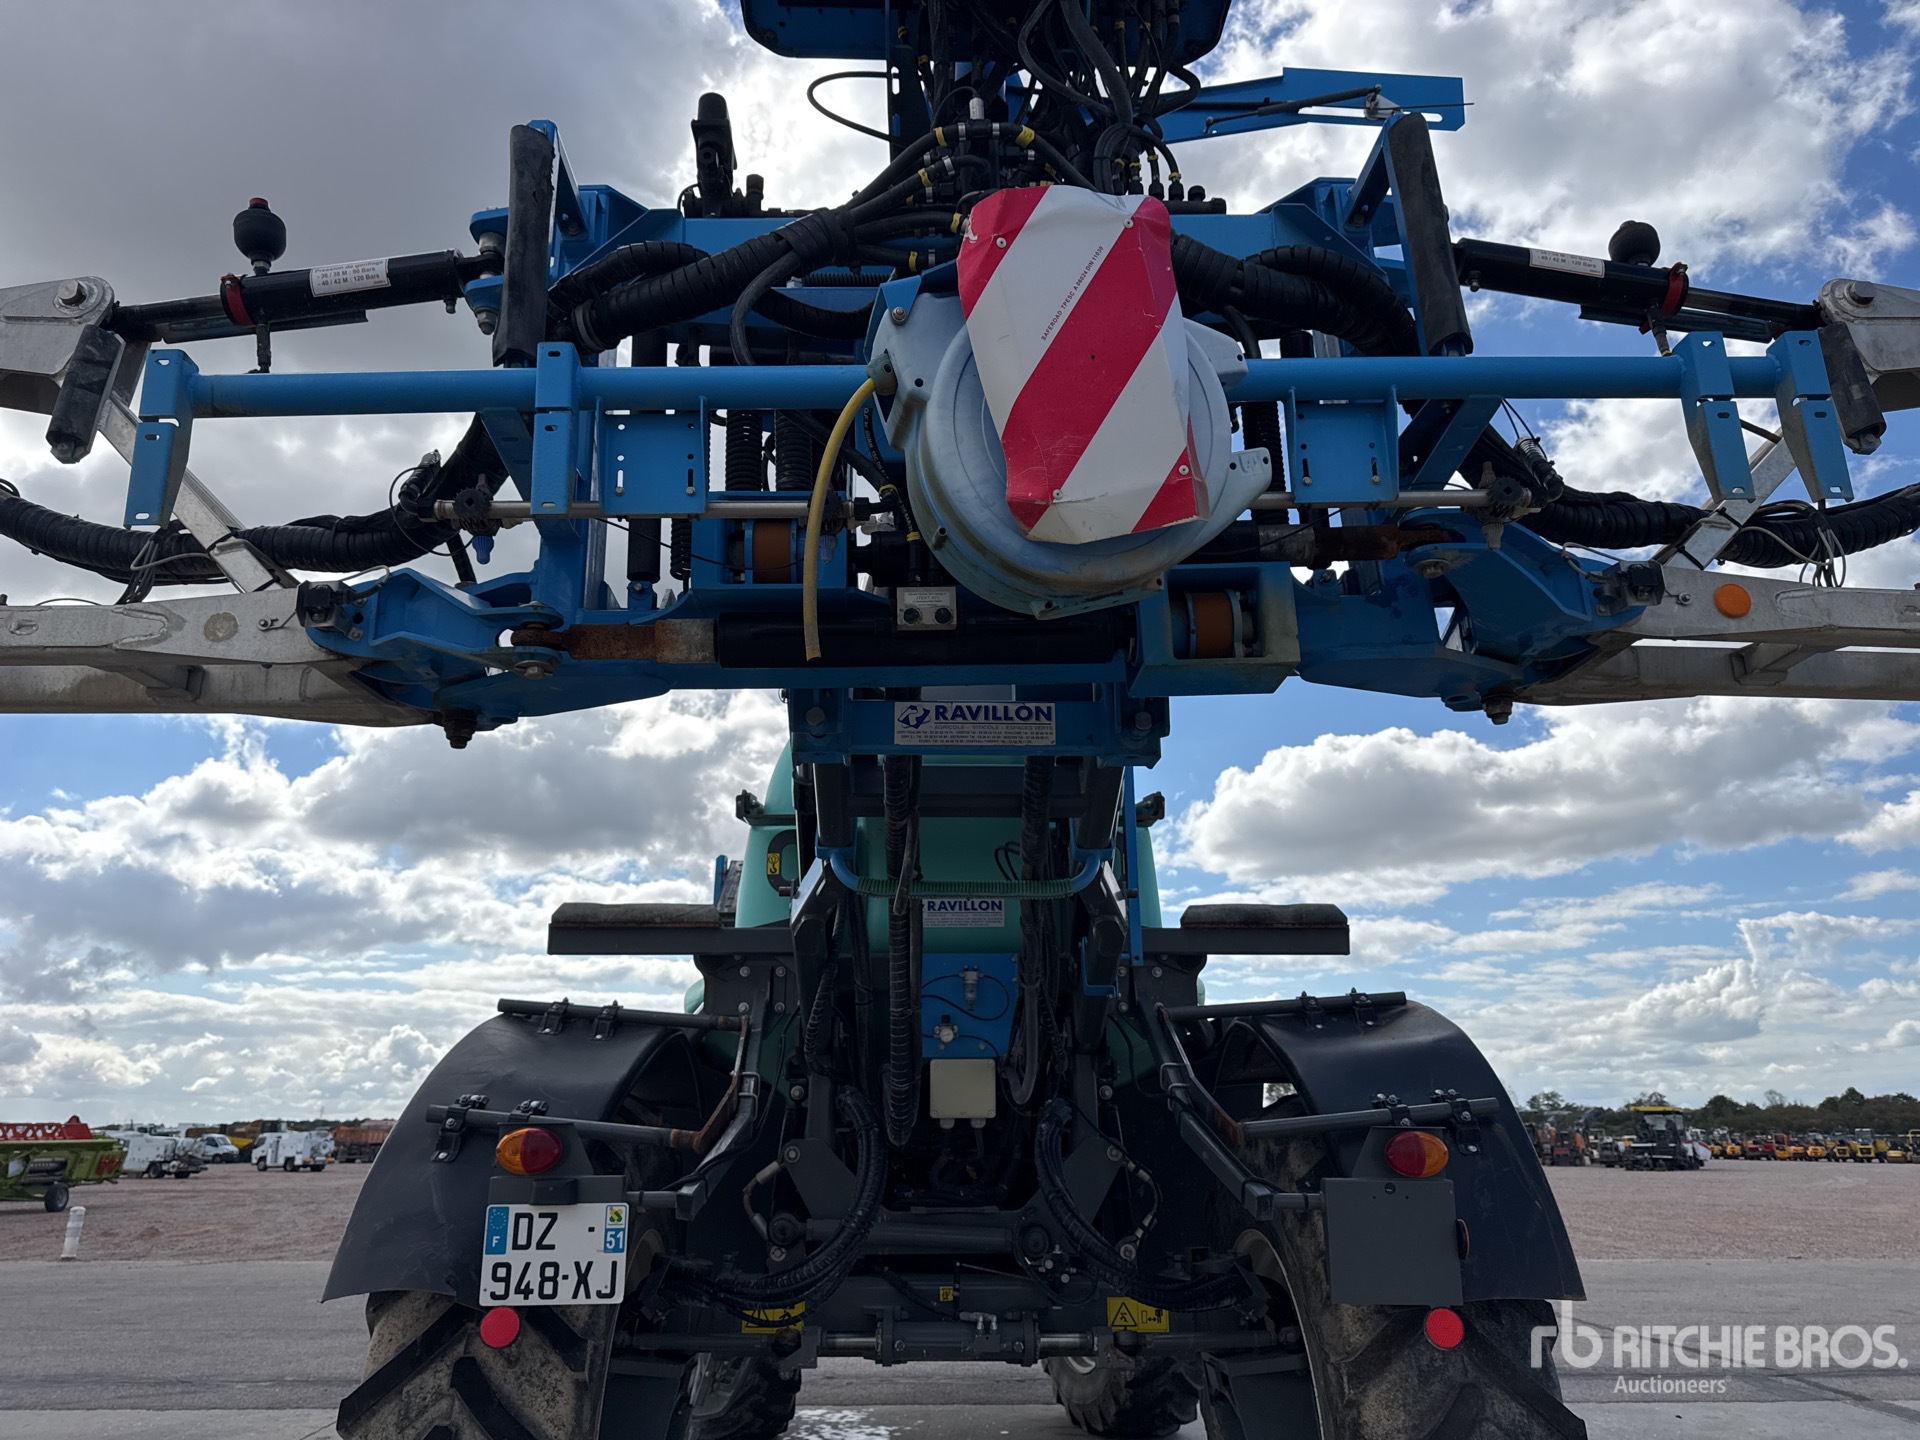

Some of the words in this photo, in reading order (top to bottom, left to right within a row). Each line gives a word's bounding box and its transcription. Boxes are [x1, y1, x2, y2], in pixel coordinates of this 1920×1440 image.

[1041, 310, 1062, 341] SAFEROAD
[1061, 291, 1075, 309] TPESC
[1086, 261, 1094, 271] DIN
[935, 705, 1052, 721] RAVILLON
[928, 901, 1002, 911] RAVILLON
[512, 1212, 558, 1250] DZ
[606, 1231, 624, 1249] 51
[492, 1236, 500, 1247] F
[490, 1260, 618, 1301] 948-XJ
